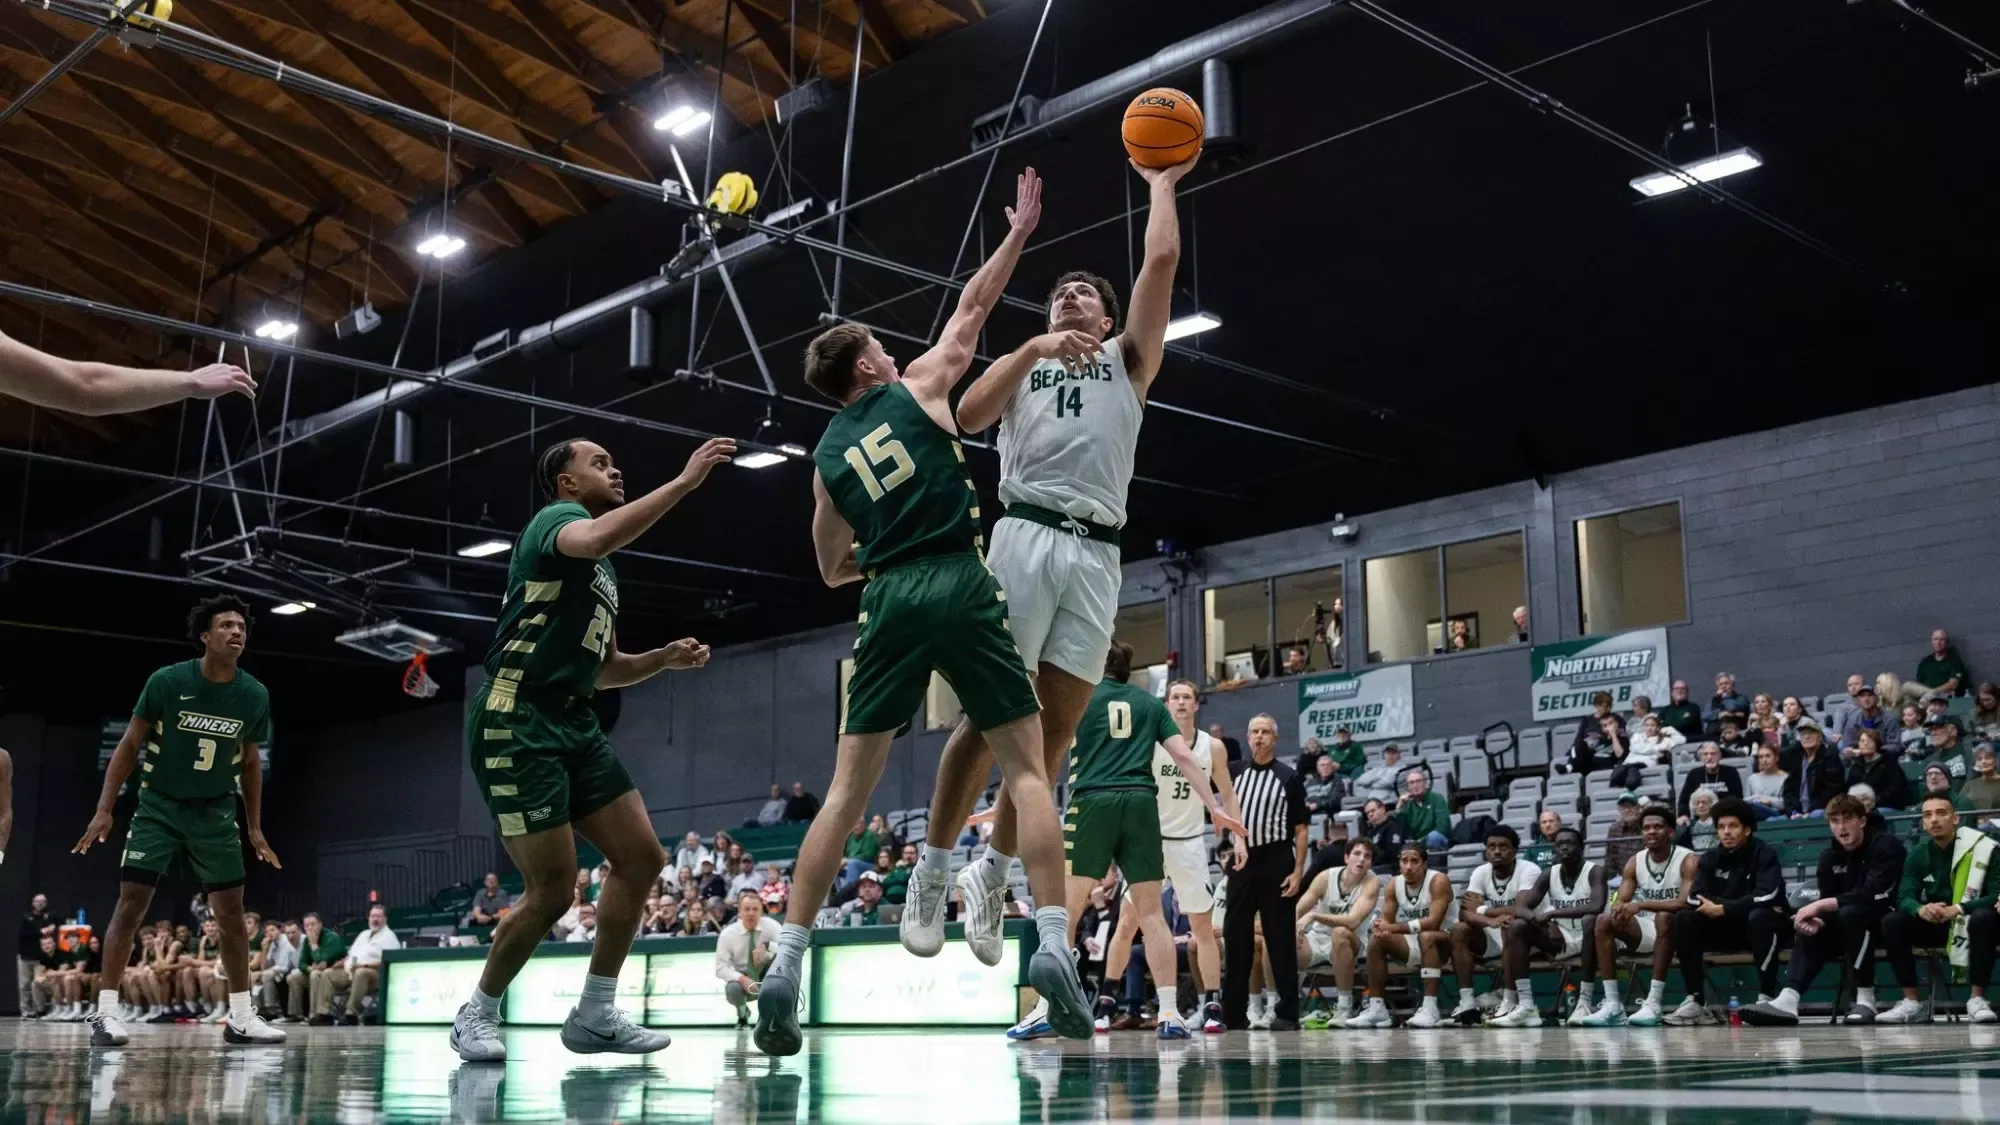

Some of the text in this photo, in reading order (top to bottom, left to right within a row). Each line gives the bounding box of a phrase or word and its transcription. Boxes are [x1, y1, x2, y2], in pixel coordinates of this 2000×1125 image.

[1137, 96, 1177, 111] NCAA
[1056, 385, 1084, 418] 14
[843, 421, 917, 503] 15
[1545, 649, 1652, 678] NORTHWEST
[1538, 685, 1632, 712] SECTIO B
[182, 714, 240, 735] MINERS
[1107, 700, 1132, 739] 0
[1308, 703, 1383, 725] RESERVED
[193, 737, 217, 772] 3
[1172, 781, 1191, 801] 35
